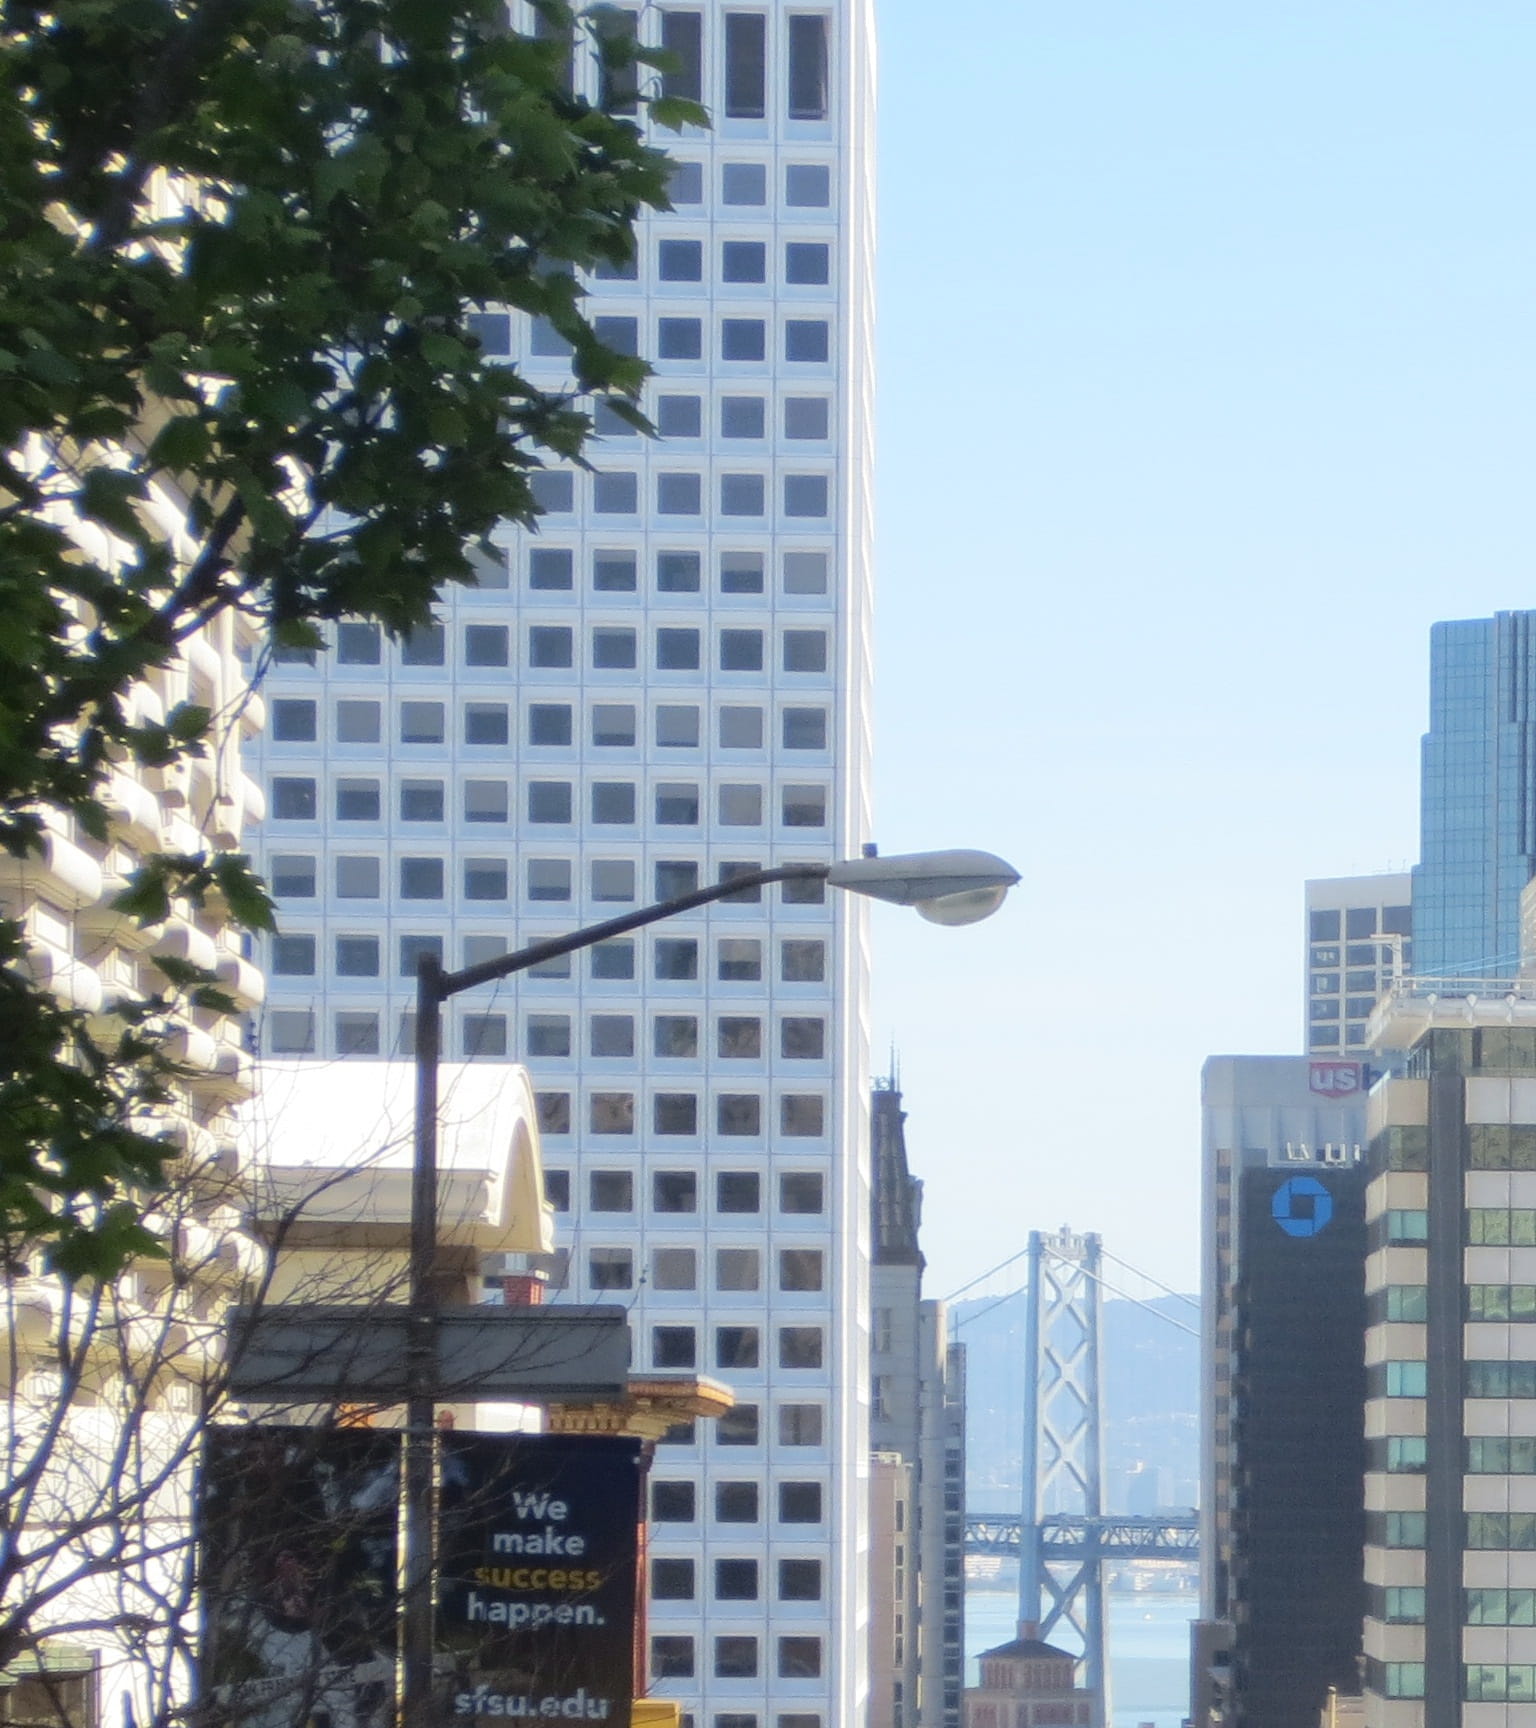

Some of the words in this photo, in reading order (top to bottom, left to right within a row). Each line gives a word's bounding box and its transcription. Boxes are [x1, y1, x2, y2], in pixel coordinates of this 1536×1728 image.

[513, 1491, 569, 1521] We
[493, 1526, 585, 1555] make
[474, 1567, 604, 1590] success
[467, 1591, 605, 1631] happen.
[454, 1683, 609, 1720] sfsu.edu
